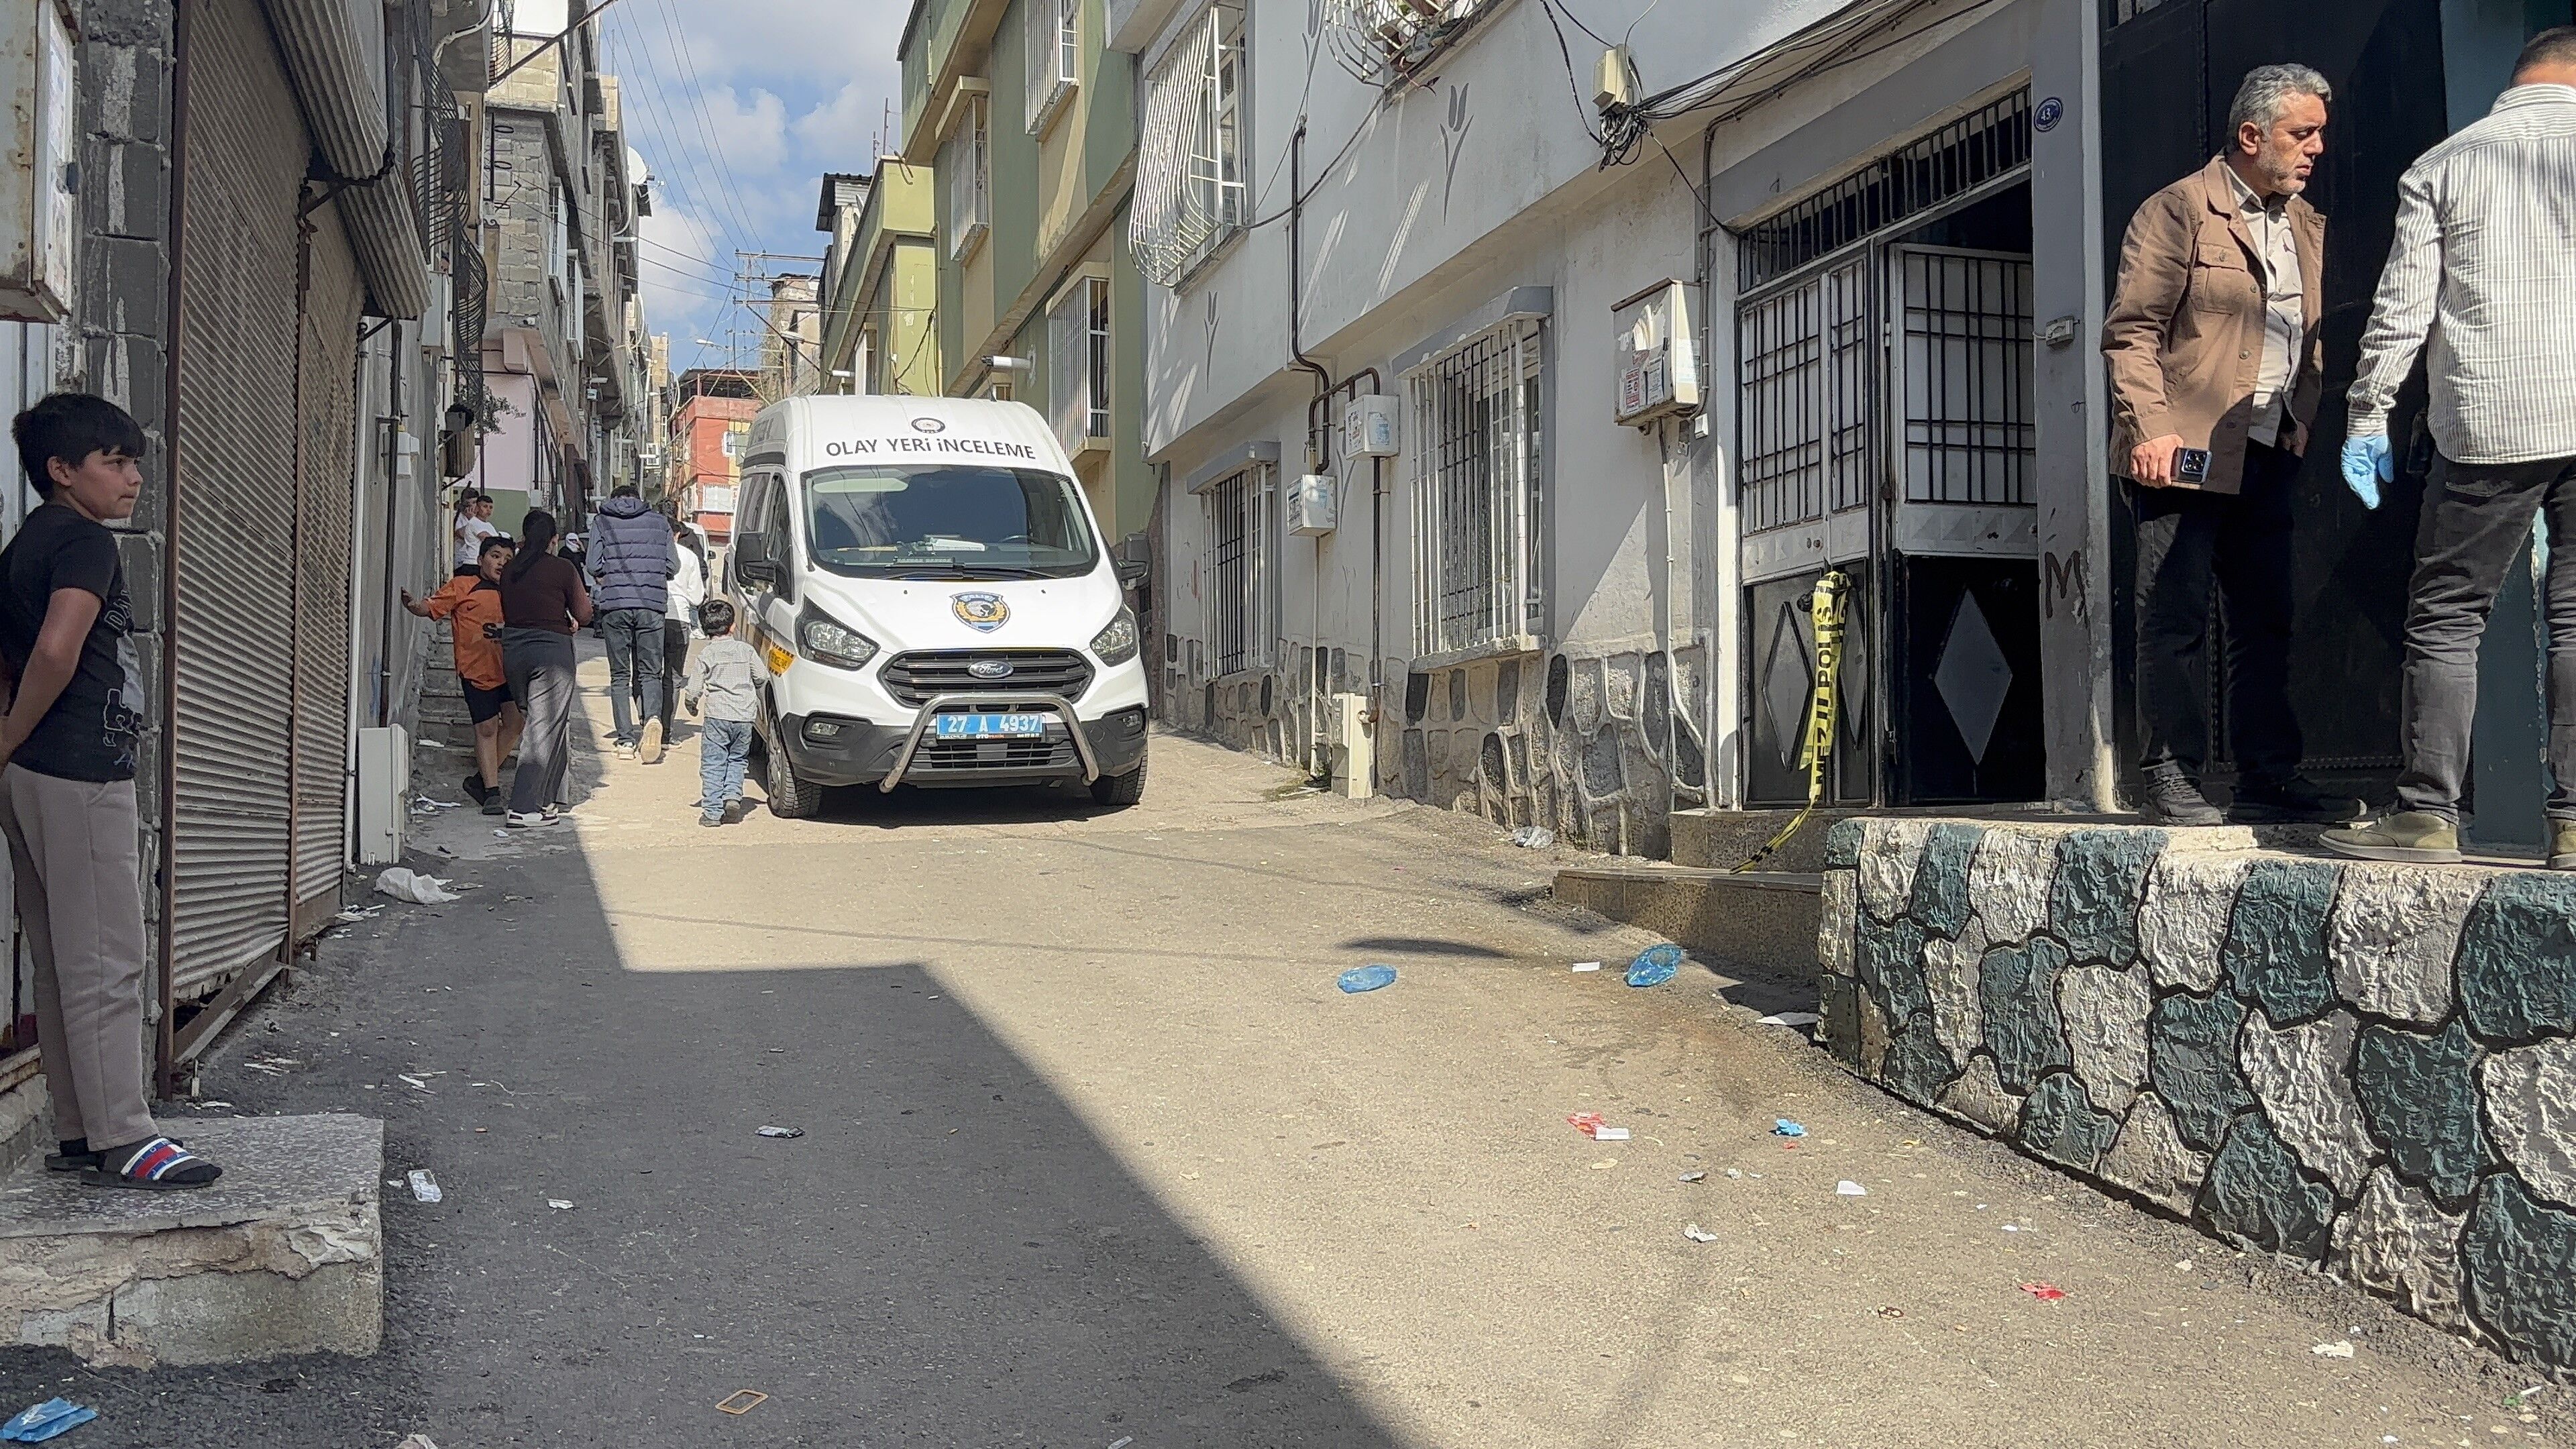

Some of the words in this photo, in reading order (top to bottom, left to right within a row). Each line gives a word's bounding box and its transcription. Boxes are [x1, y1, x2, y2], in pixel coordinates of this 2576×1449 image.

[2041, 108, 2051, 121] 43
[826, 439, 877, 457] OLAY
[979, 663, 1004, 674] Ford
[947, 715, 967, 733] 27
[978, 715, 989, 733] A
[1000, 714, 1039, 732] 4937
